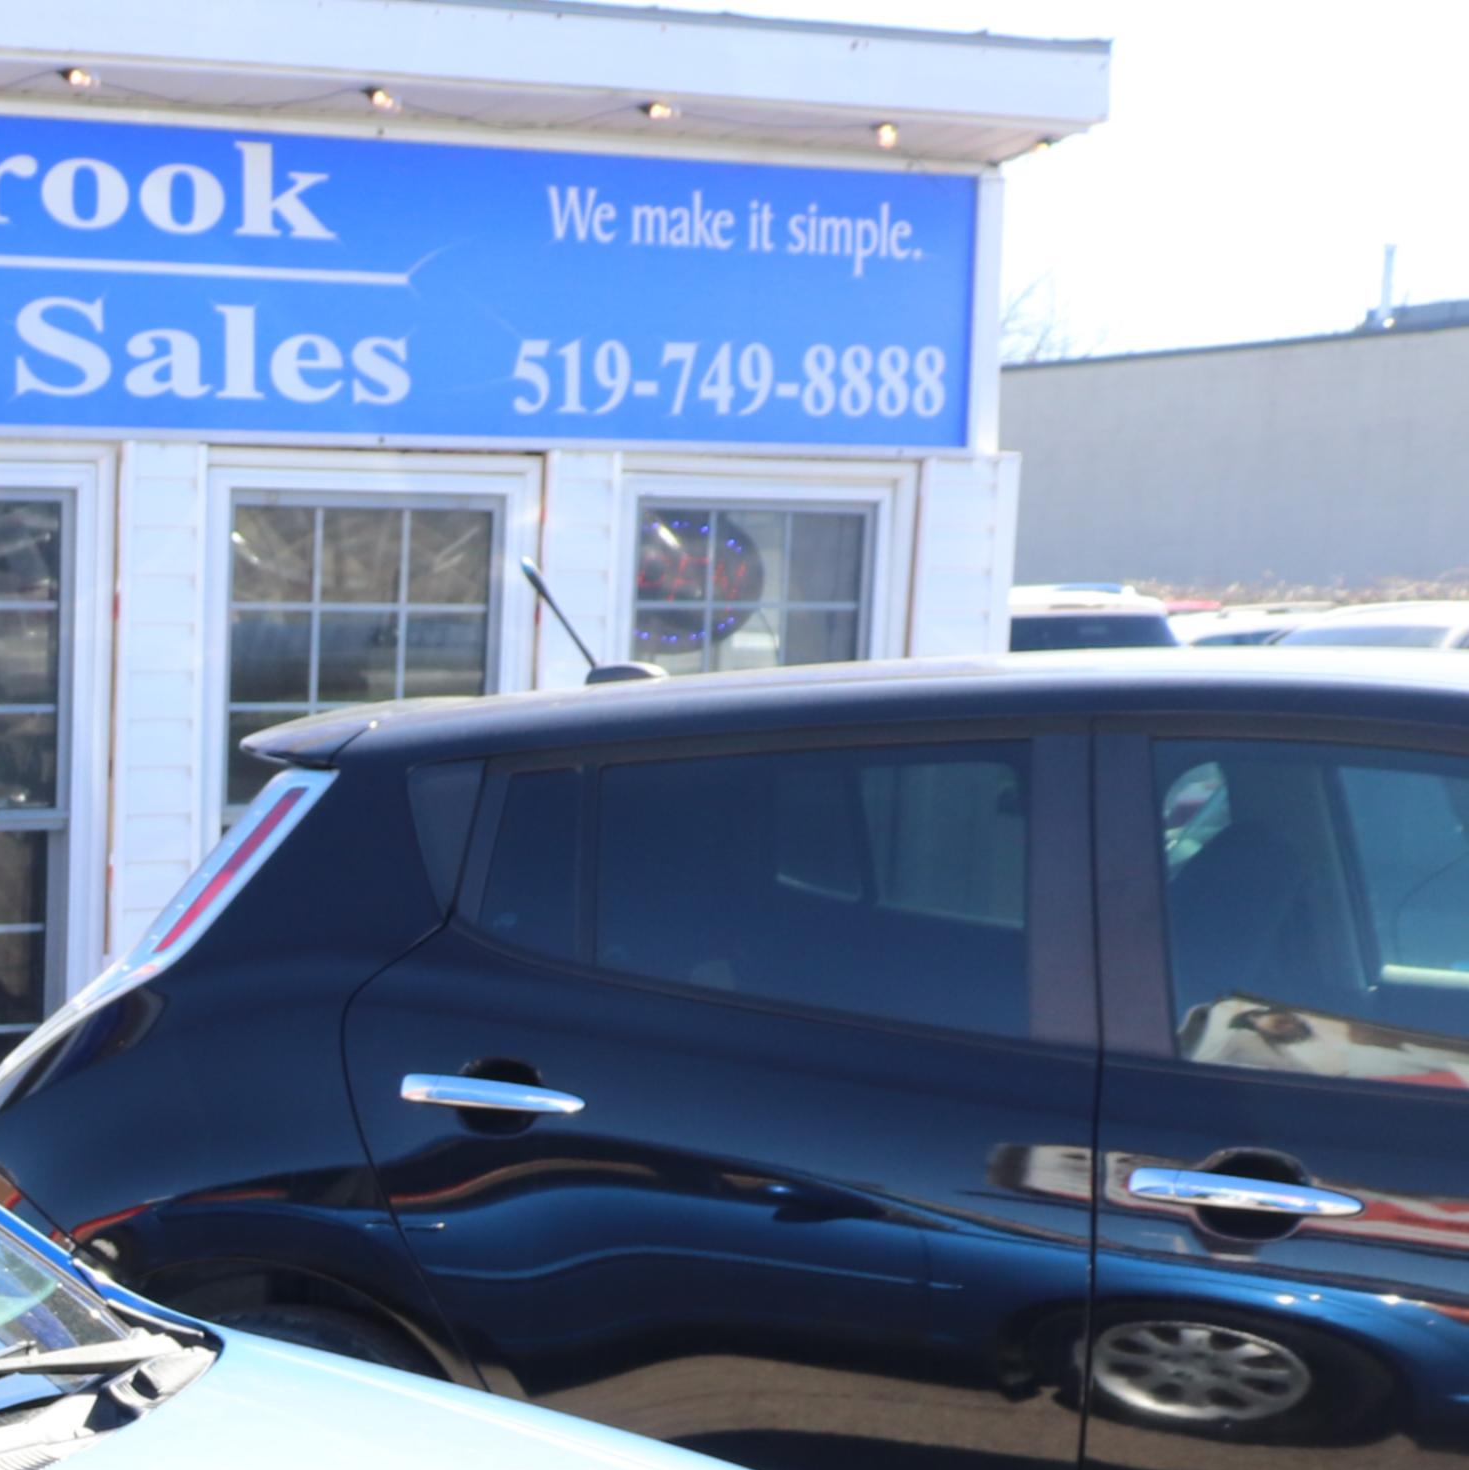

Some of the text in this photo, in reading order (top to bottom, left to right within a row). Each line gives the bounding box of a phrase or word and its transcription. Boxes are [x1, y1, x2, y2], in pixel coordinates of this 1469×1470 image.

[548, 185, 923, 276] We make it simple.
[14, 295, 412, 405] Sales
[512, 338, 947, 418] 519-749-8888
